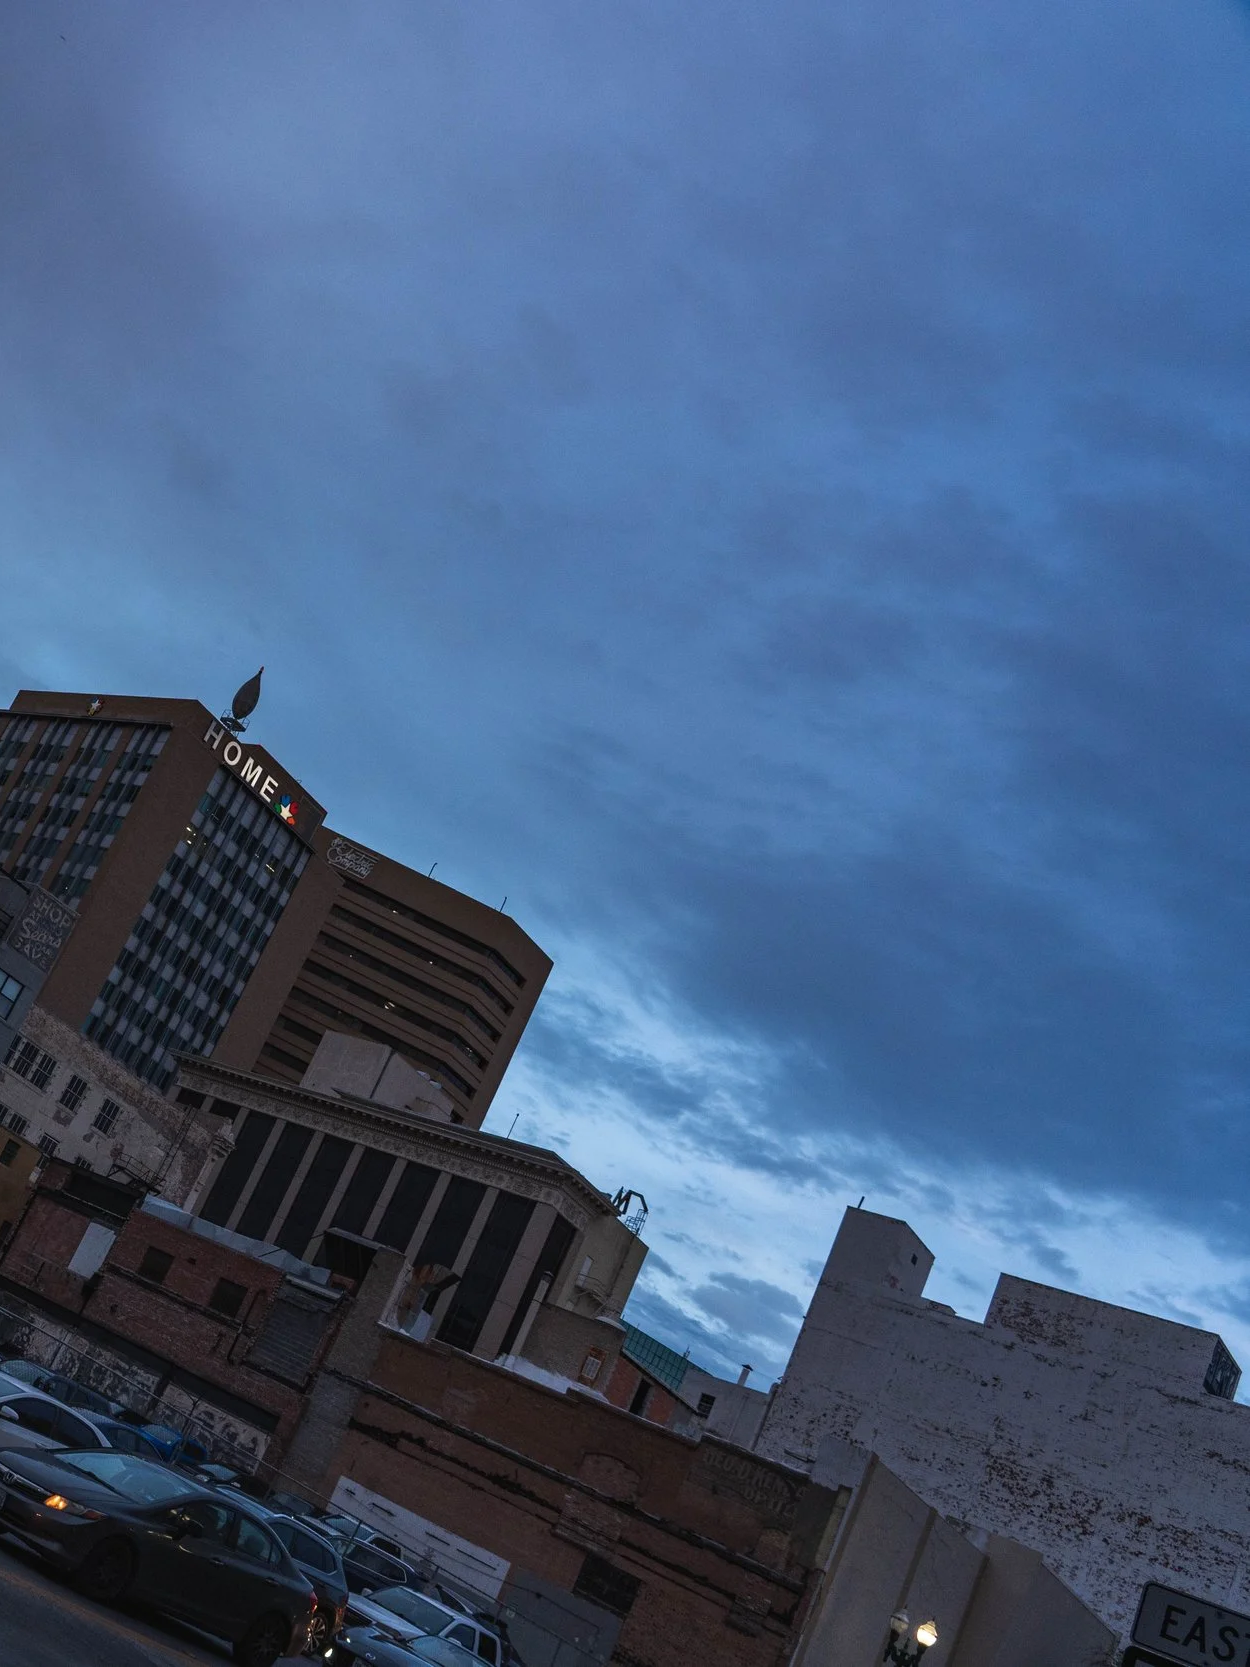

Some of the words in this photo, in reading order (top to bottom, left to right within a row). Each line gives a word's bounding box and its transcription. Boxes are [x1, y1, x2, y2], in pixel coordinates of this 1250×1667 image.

[202, 719, 280, 804] HOME
[32, 894, 73, 928] SHOP
[1160, 1603, 1250, 1664] EAS
